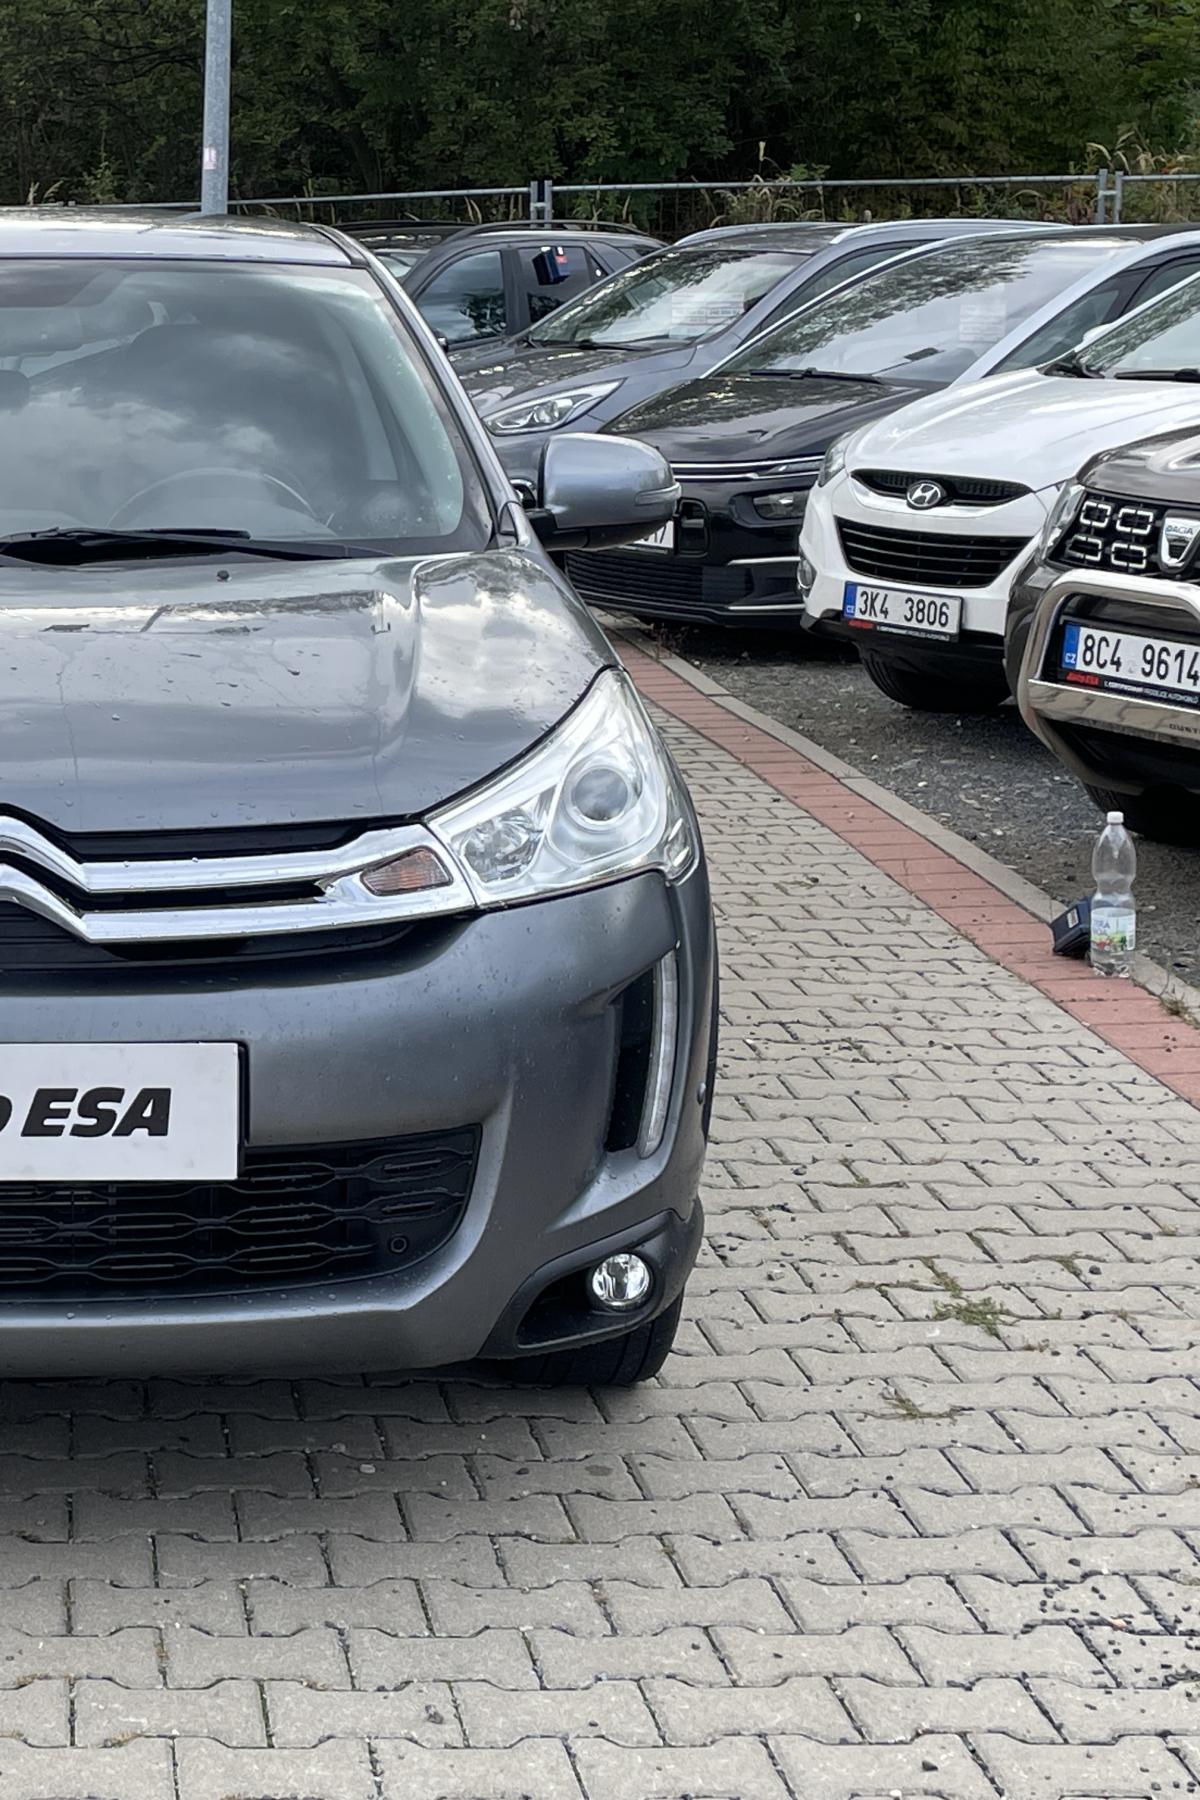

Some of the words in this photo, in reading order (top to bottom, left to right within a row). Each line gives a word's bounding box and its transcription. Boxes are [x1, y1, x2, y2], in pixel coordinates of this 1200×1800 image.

[859, 590, 889, 619] 3K4
[904, 597, 950, 628] 3806
[1065, 653, 1076, 665] CZ
[1082, 634, 1122, 673] 8C4
[1141, 644, 1200, 687] 9614
[20, 1087, 172, 1138] ESA
